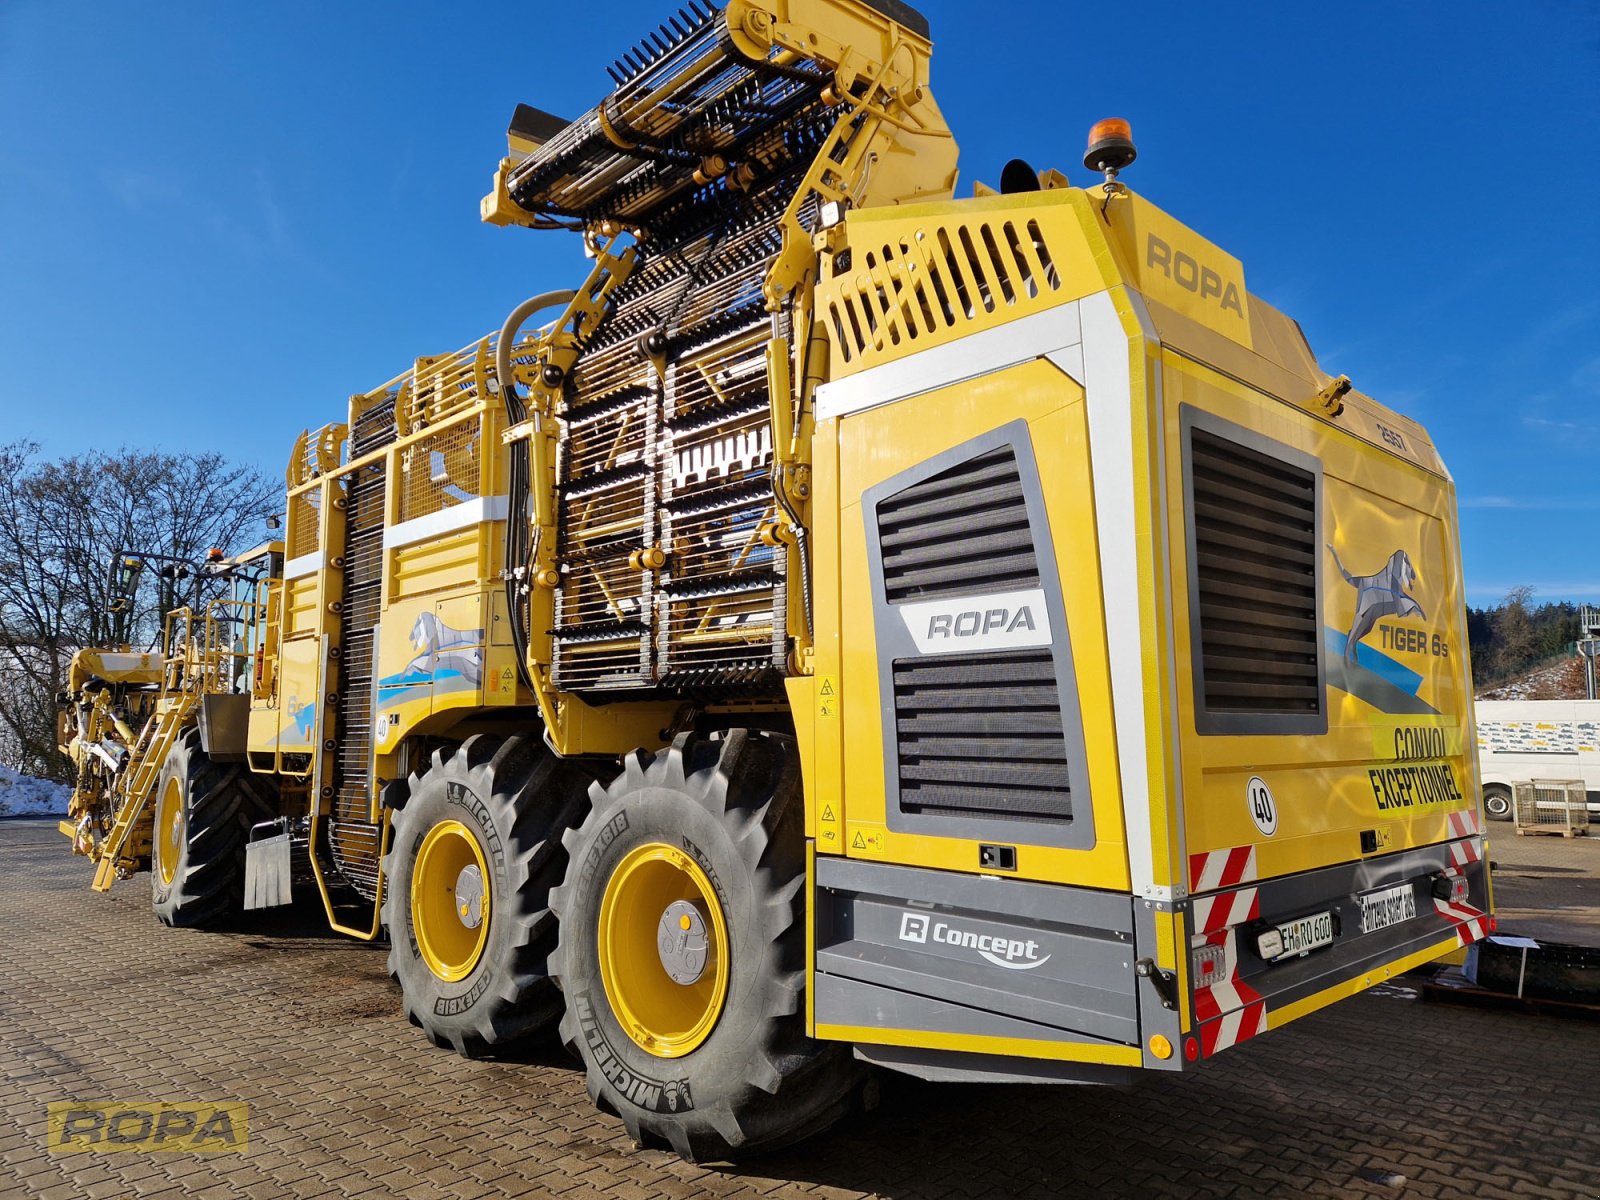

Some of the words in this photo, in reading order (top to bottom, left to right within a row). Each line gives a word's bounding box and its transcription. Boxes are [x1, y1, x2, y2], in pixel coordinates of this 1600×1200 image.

[1147, 232, 1244, 319] ROPA
[927, 606, 1036, 639] ROPA
[1379, 624, 1427, 655] TIGER
[378, 719, 387, 737] 40
[1394, 727, 1447, 761] CONVOI
[1252, 787, 1273, 824] 40
[1368, 764, 1462, 810] EXCEPTIONNEL
[932, 923, 1039, 961] Concept
[1281, 926, 1295, 952] EH
[1300, 921, 1312, 946] RO
[1314, 916, 1330, 941] 600
[436, 969, 491, 1015] CEREXBIB
[574, 996, 661, 1111] MICHELIN
